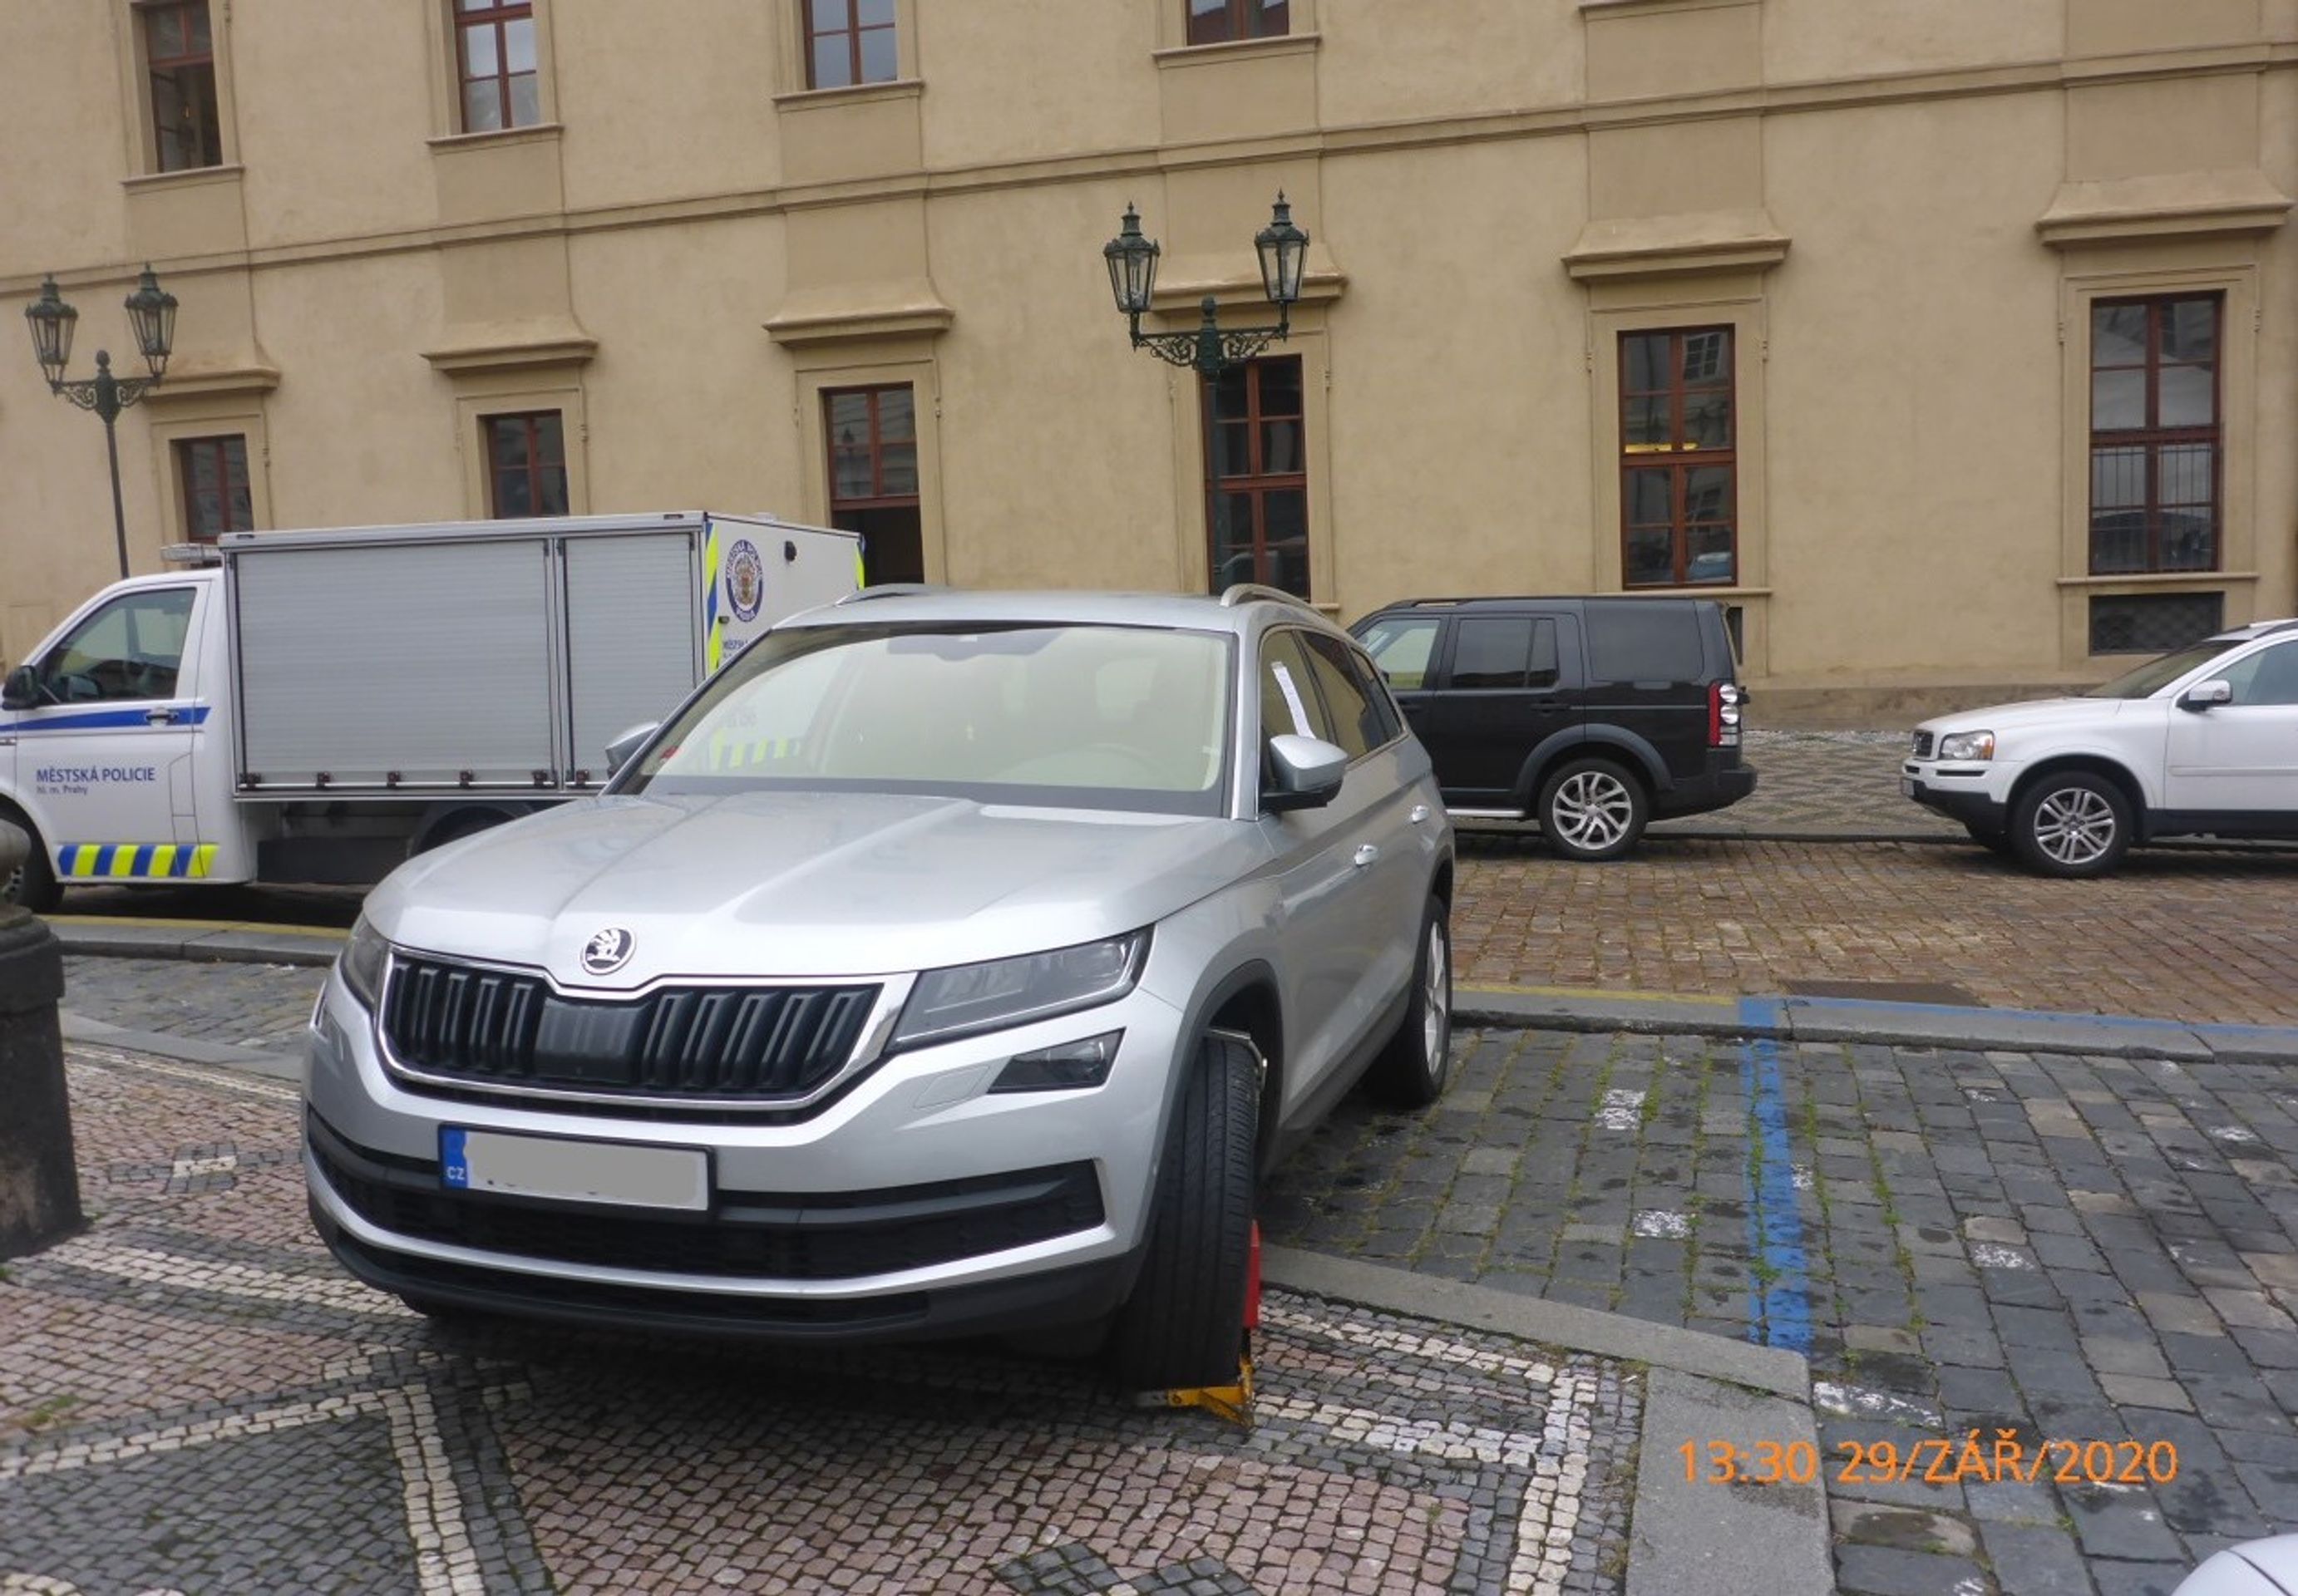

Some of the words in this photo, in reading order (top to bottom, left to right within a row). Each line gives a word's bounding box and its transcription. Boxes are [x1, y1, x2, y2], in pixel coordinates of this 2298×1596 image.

[36, 765, 99, 782] MĚSTSKÁ
[101, 766, 155, 781] POLICIE
[446, 1165, 465, 1180] CZ
